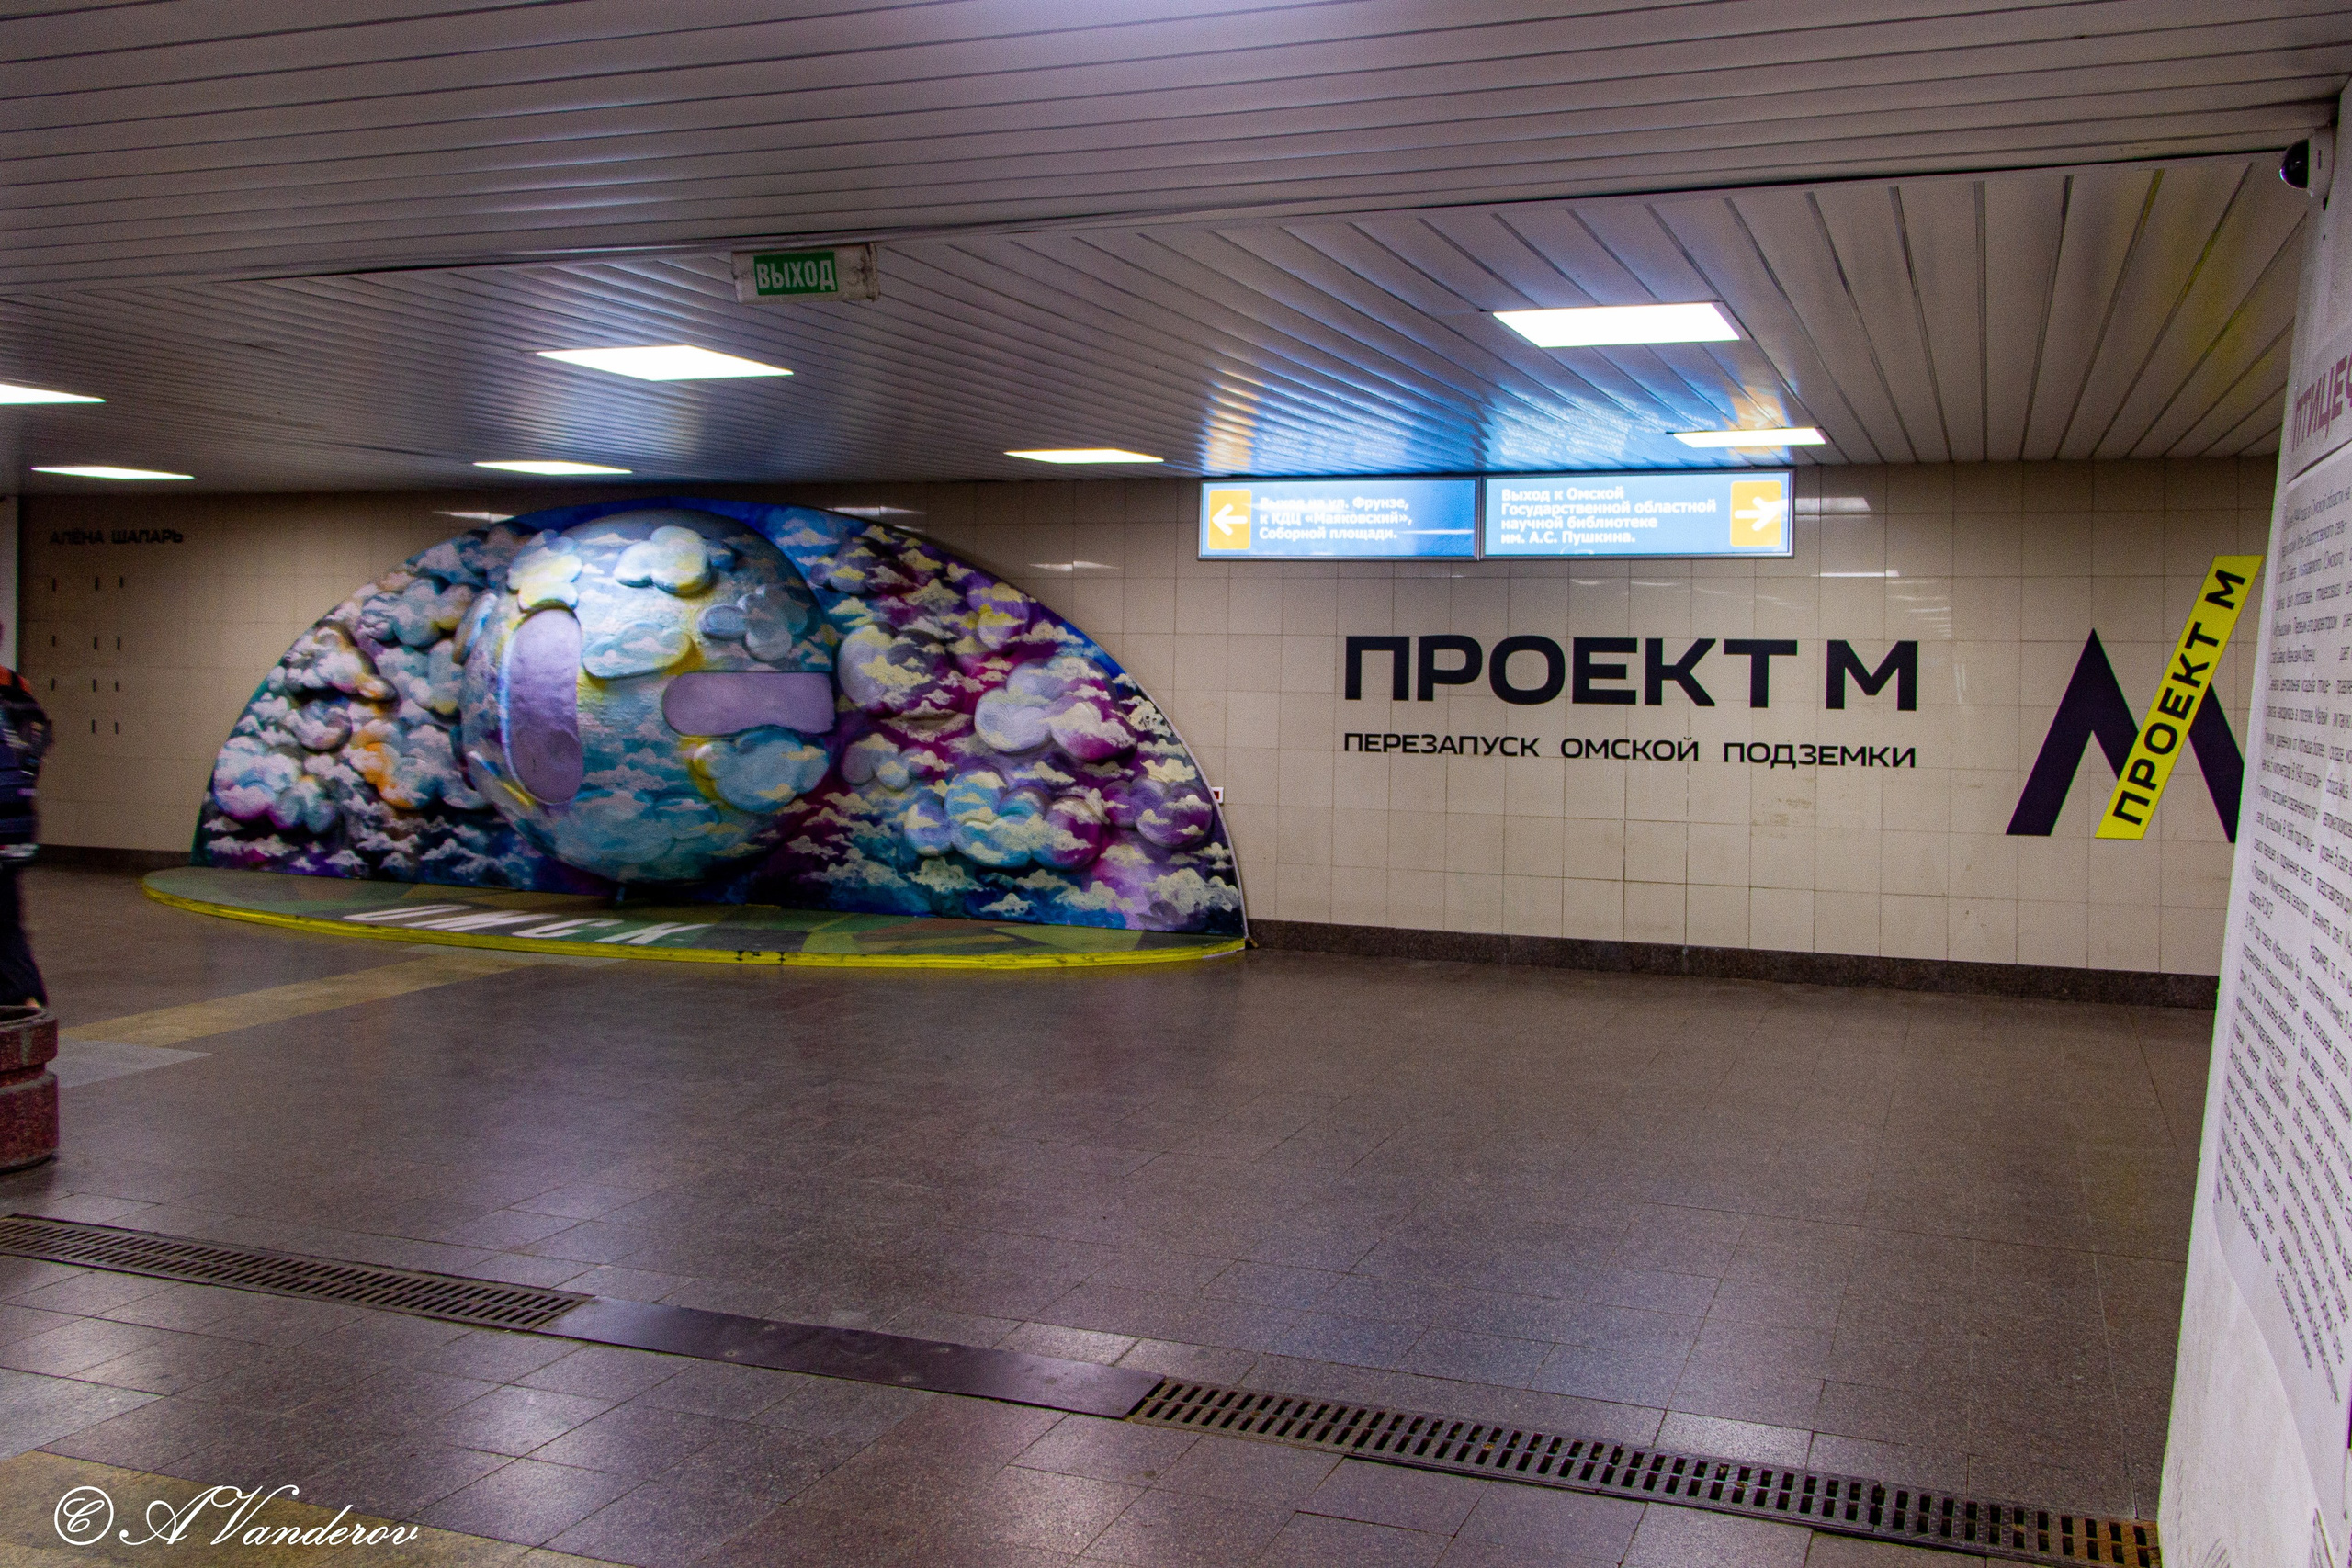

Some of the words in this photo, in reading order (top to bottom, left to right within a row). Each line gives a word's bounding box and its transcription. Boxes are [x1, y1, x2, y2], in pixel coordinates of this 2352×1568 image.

[755, 259, 837, 291] ВЫХОД
[1501, 488, 1551, 502] Выход
[1554, 491, 1563, 501] к
[1566, 486, 1624, 502] Омской
[1352, 496, 1409, 512] Фрунзе,
[1501, 501, 1631, 517] Государственной
[1634, 499, 1717, 513] областной
[1260, 513, 1268, 525] к
[1272, 512, 1302, 526] КДЦ
[1305, 511, 1412, 526] «Маяковский»,
[1500, 516, 1563, 532] научной
[1566, 515, 1657, 529] библиотеке
[110, 528, 185, 545] ШАПАРЬ
[1259, 526, 1327, 542] Соборной
[1329, 528, 1397, 541] площади.
[1500, 533, 1526, 545] им.
[1529, 531, 1558, 544] А.С.
[1562, 531, 1636, 547] Пушкина.
[1345, 634, 1799, 709] ПРОЕКТ
[1825, 638, 1919, 712] М
[2111, 620, 2220, 826] ПРОЕКТ
[2204, 569, 2246, 610] М
[1342, 731, 1541, 758] ПЕРЕЗАПУСК
[1559, 736, 1700, 761] ОМСКОЙ
[1723, 741, 1917, 771] ПОДЗЕМКИ
[343, 903, 717, 945] ОМСК
